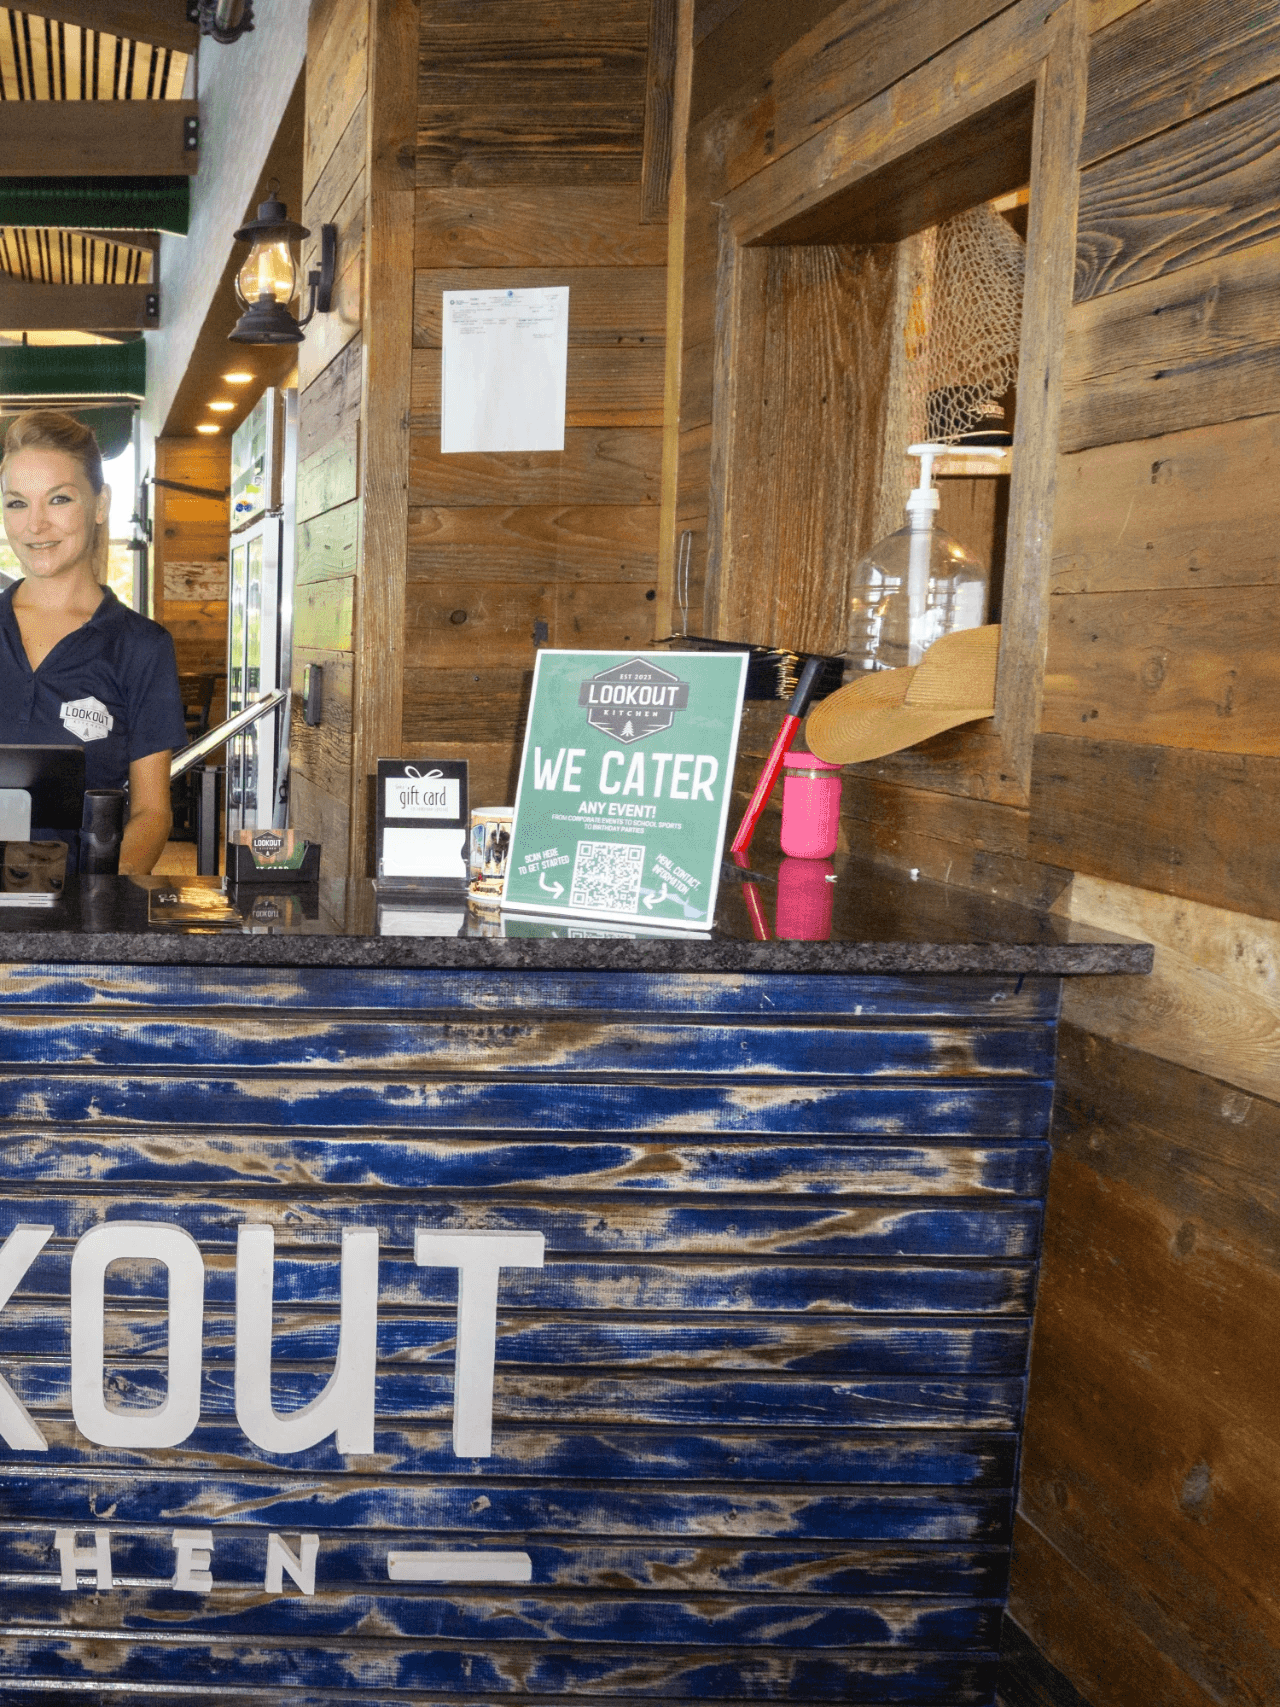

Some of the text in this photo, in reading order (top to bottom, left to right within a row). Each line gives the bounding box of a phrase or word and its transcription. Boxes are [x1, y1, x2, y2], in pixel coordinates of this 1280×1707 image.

[588, 684, 679, 706] LOOKOUT
[65, 706, 109, 726] LOOKOUT
[603, 709, 658, 717] KITCHEN
[534, 746, 719, 801] WE CATER
[400, 785, 446, 809] gift card
[578, 800, 657, 819] ANY EVENT!
[568, 815, 601, 823] CORPORATE
[601, 817, 624, 825] EVENTS
[633, 820, 657, 828] SCHOOL
[658, 822, 682, 830] SPORTS
[592, 824, 620, 832] BIRTHDAY
[620, 826, 645, 834] PARTIES
[254, 839, 281, 847] LOOKOUT
[524, 847, 559, 863] SCAN HERE
[518, 855, 570, 875] TO GET STARTED
[652, 864, 690, 895] INFORMATION
